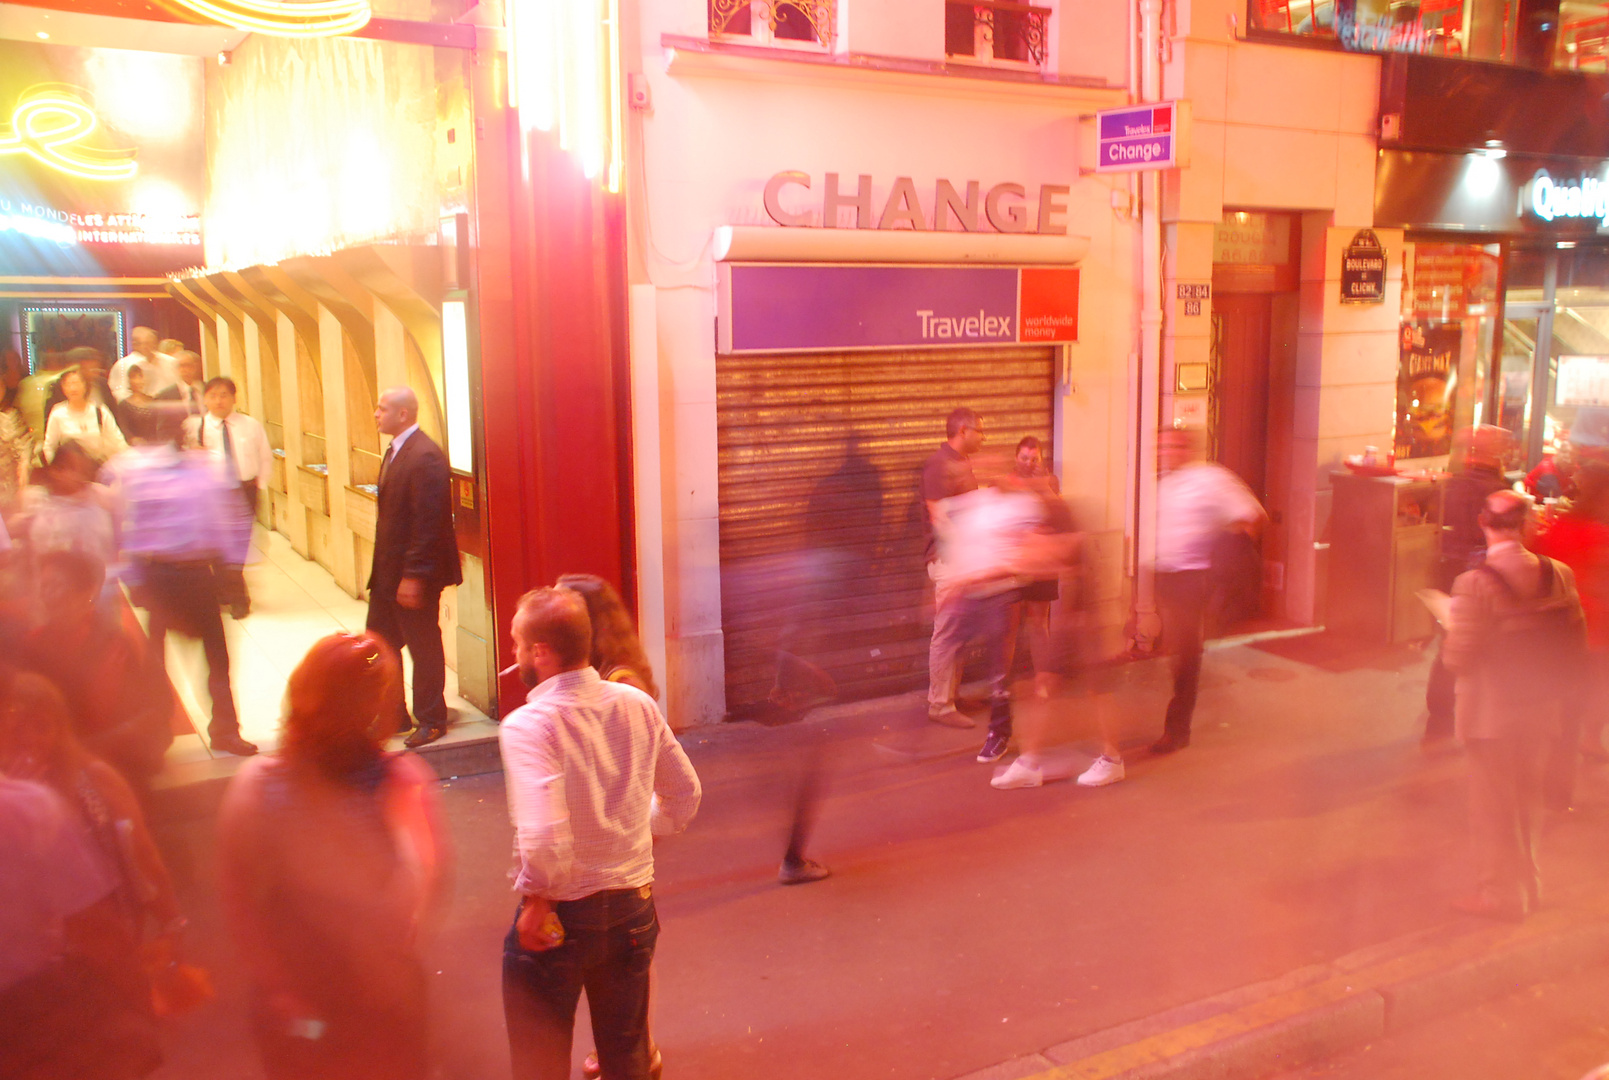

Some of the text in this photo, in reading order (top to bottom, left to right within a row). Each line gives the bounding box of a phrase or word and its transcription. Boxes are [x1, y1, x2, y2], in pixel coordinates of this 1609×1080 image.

[1109, 142, 1161, 162] Change
[763, 169, 1070, 235] CHANGE
[21, 203, 77, 226] MONDE
[78, 229, 201, 245] INTERNATLES
[1346, 258, 1383, 272] BOULEVARD
[1178, 285, 1209, 298] 82 84
[1351, 282, 1376, 295] CLICHY
[1186, 302, 1199, 314] 86
[916, 309, 1011, 339] Travelex
[1025, 315, 1073, 327] worldwide
[1024, 328, 1056, 338] money
